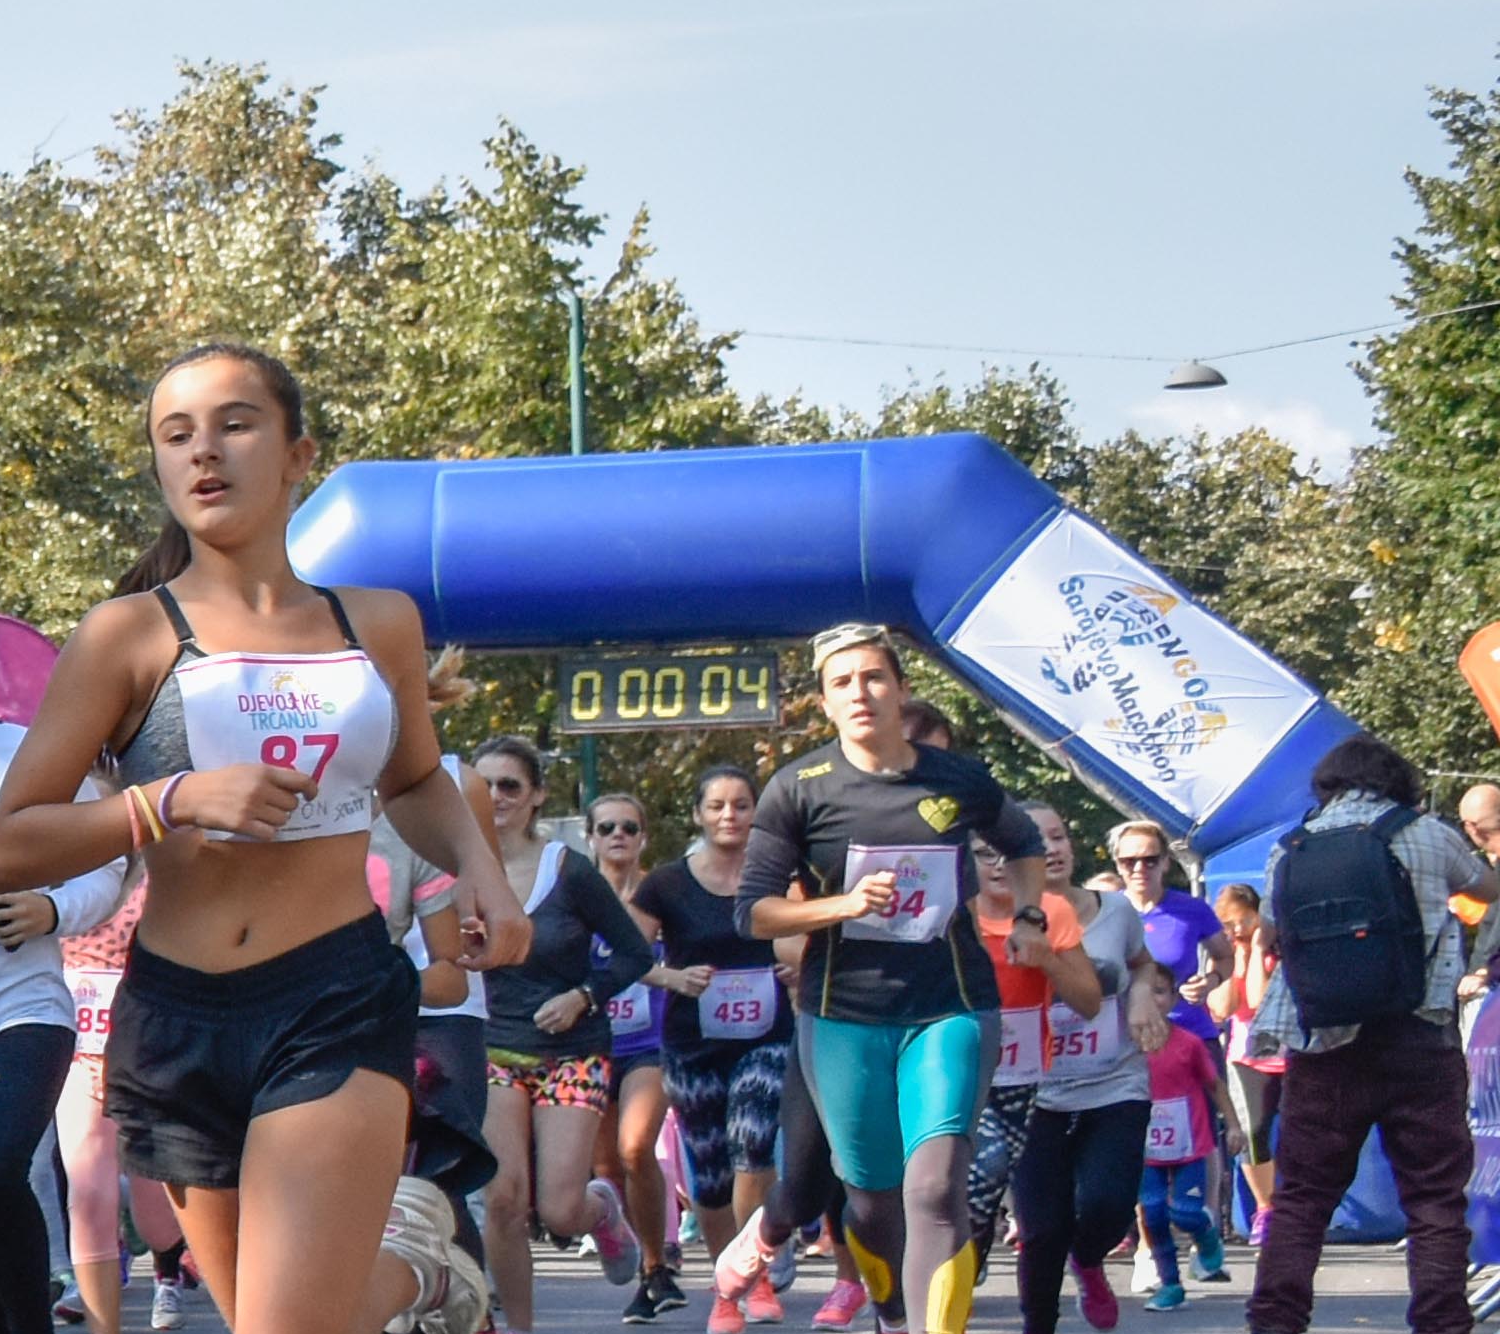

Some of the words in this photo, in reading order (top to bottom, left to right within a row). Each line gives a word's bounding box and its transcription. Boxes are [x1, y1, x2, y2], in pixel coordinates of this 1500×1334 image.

[1058, 575, 1120, 678] Sarajevo
[1108, 672, 1176, 783] Marathon
[260, 733, 340, 787] 87
[715, 1000, 761, 1023] 453
